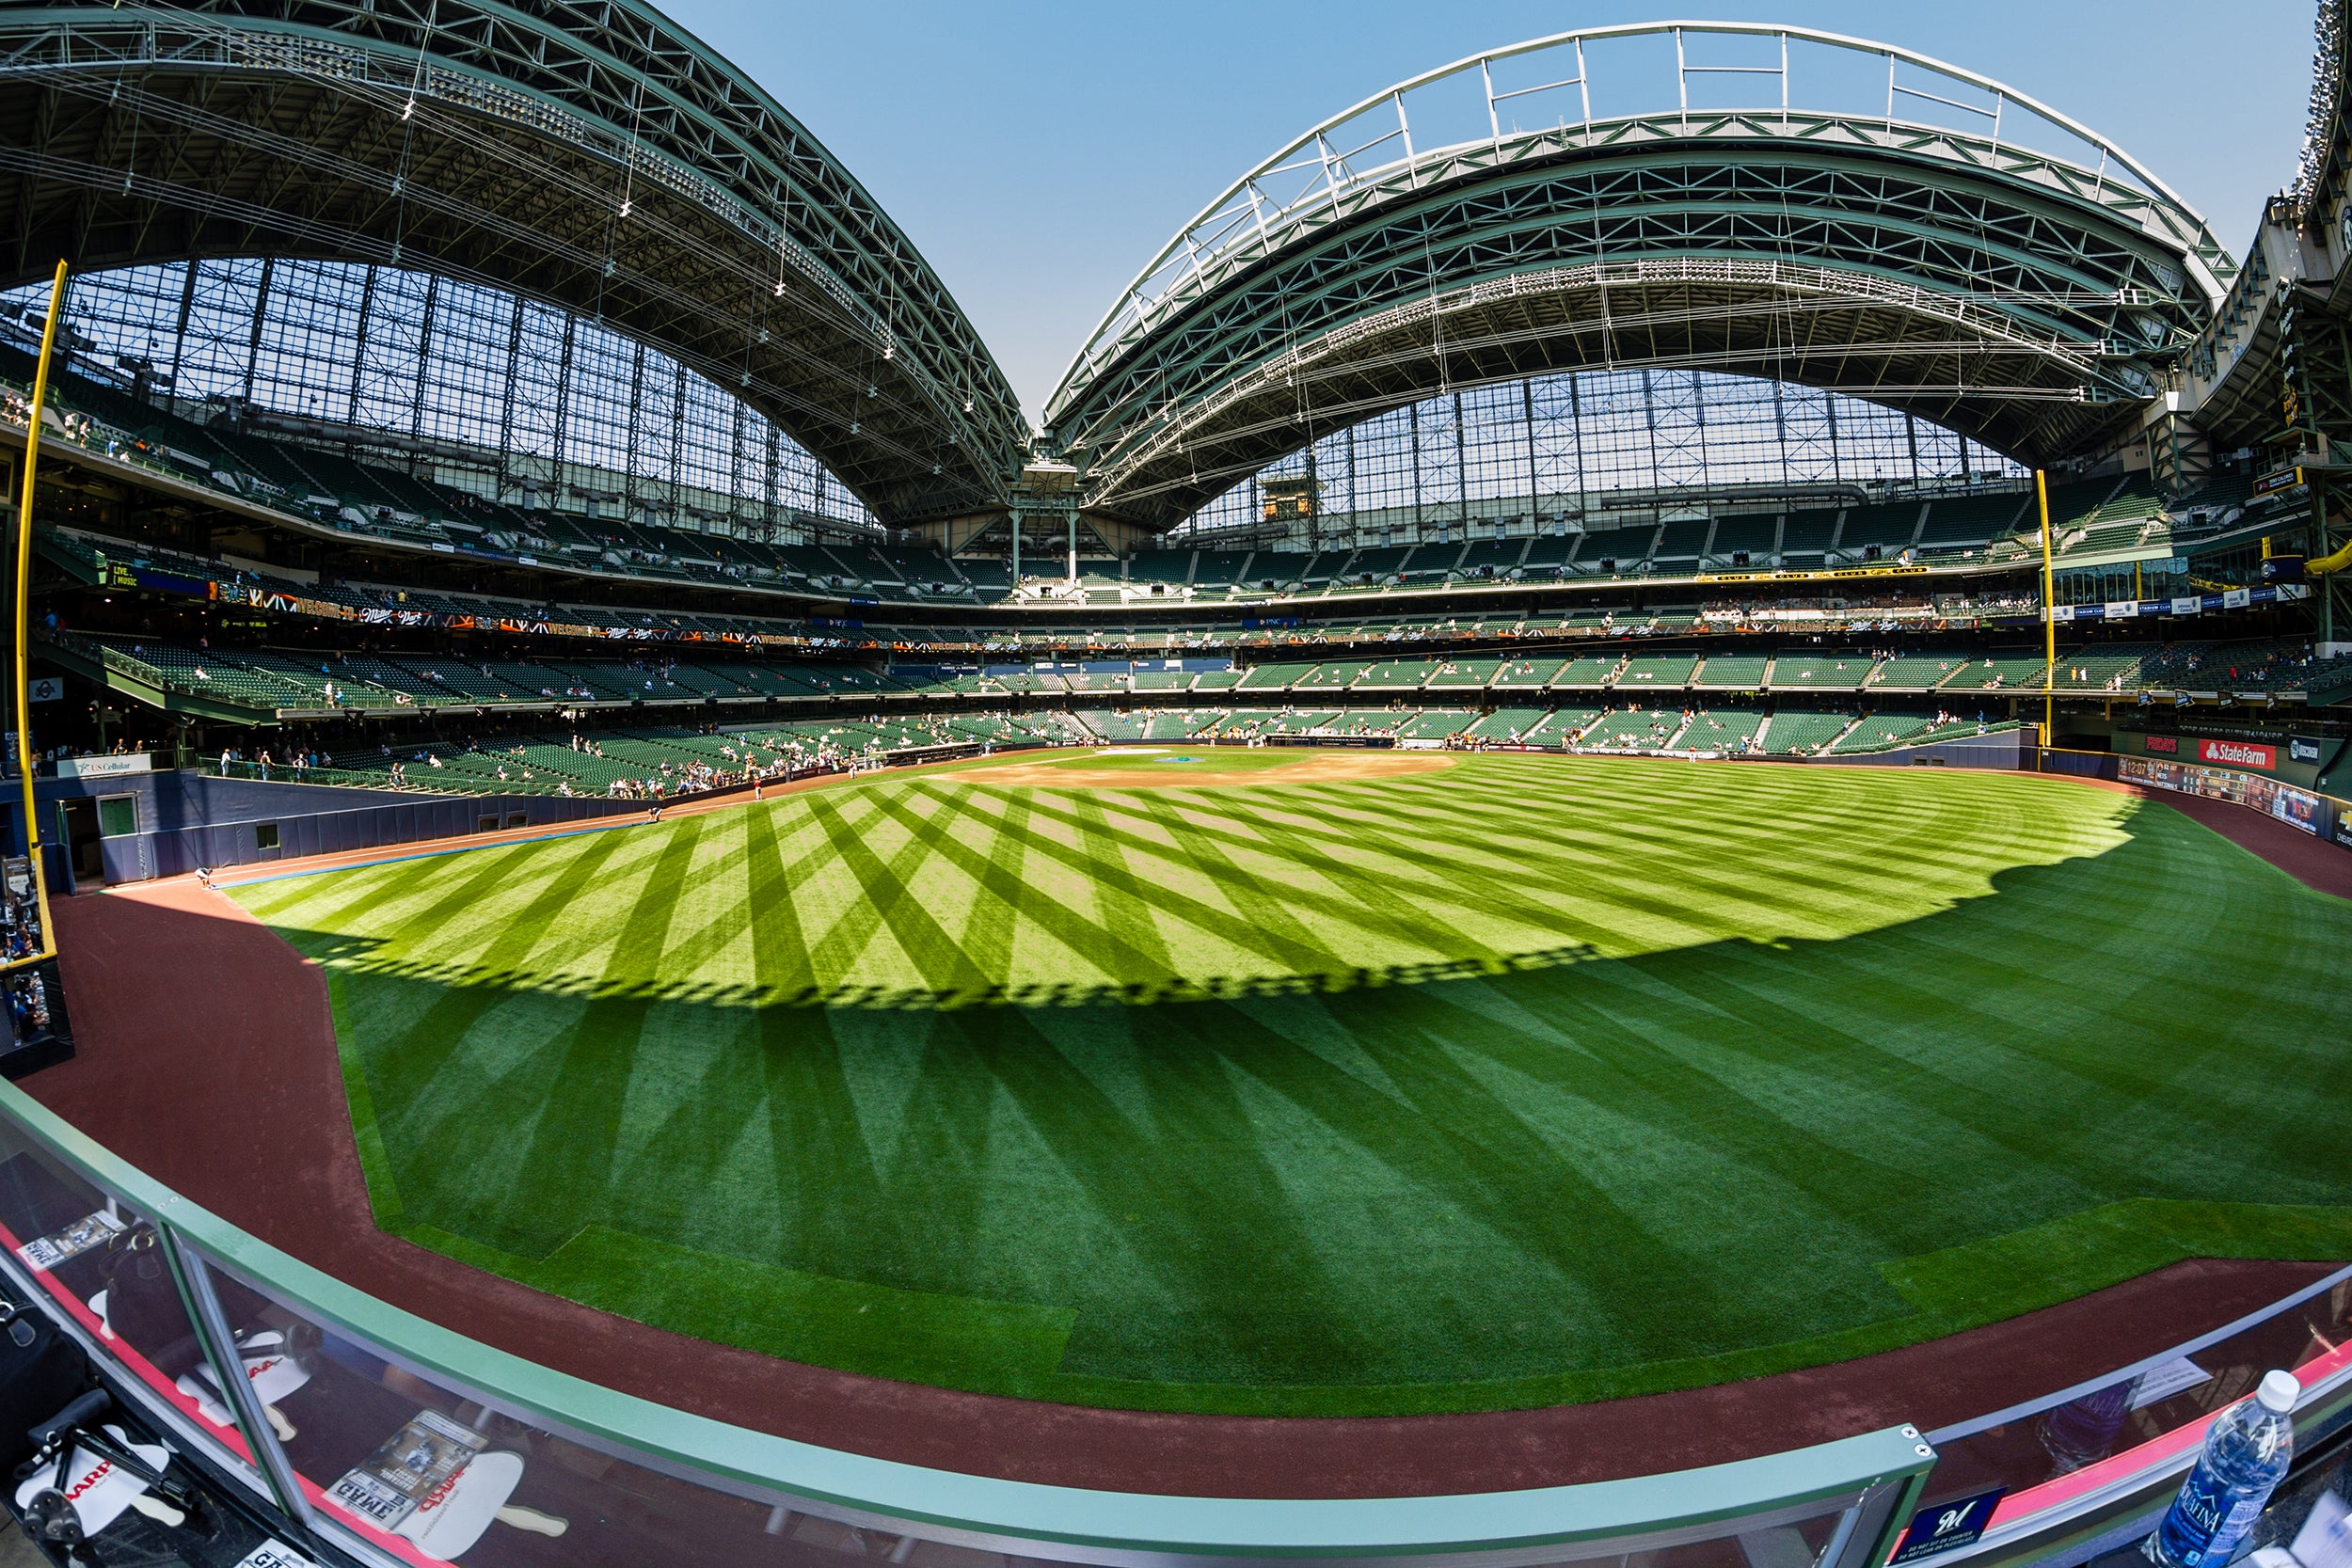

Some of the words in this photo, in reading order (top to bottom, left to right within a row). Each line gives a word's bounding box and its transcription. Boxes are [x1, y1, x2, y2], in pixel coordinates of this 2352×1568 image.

[118, 577, 137, 586] MUSIC
[296, 596, 341, 619] WELCOME
[342, 606, 354, 621] TO
[362, 608, 393, 624] Miller
[398, 610, 422, 626] Park
[548, 623, 589, 636] WELCOME
[1778, 623, 1825, 632] WELCOME
[1848, 621, 1872, 632] Miller
[1877, 621, 1899, 631] Park
[1544, 627, 1587, 637] WELCOME
[761, 635, 795, 645] WELCOME
[1327, 634, 1364, 643] WELCOME
[931, 641, 966, 651] WELCOME
[103, 762, 131, 770] Cellular
[2128, 762, 2146, 774] 12:07
[1948, 1530, 1973, 1542] COUNTER
[1944, 1535, 1975, 1548] PLEXIGLASS
